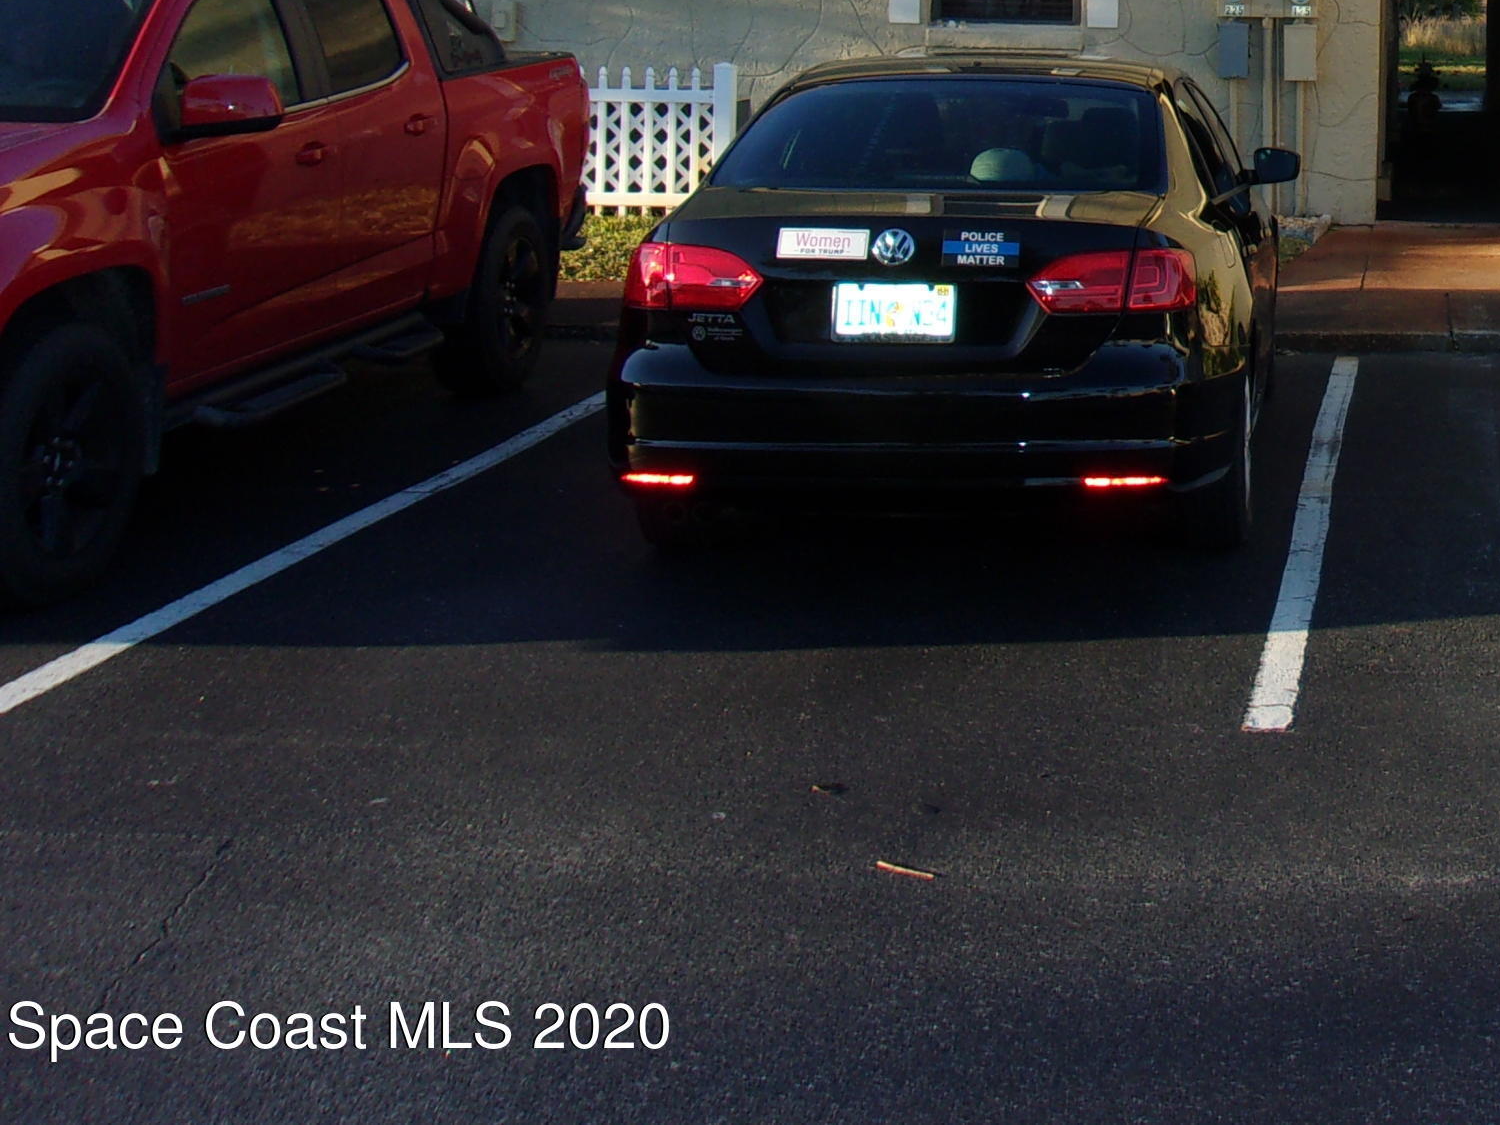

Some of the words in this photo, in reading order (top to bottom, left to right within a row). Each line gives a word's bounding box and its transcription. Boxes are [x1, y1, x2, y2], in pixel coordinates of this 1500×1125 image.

[795, 232, 851, 249] Women
[961, 231, 1004, 242] POLICE
[965, 243, 999, 254] LIVES
[957, 254, 1005, 266] MATTER
[687, 312, 736, 324] JETTA
